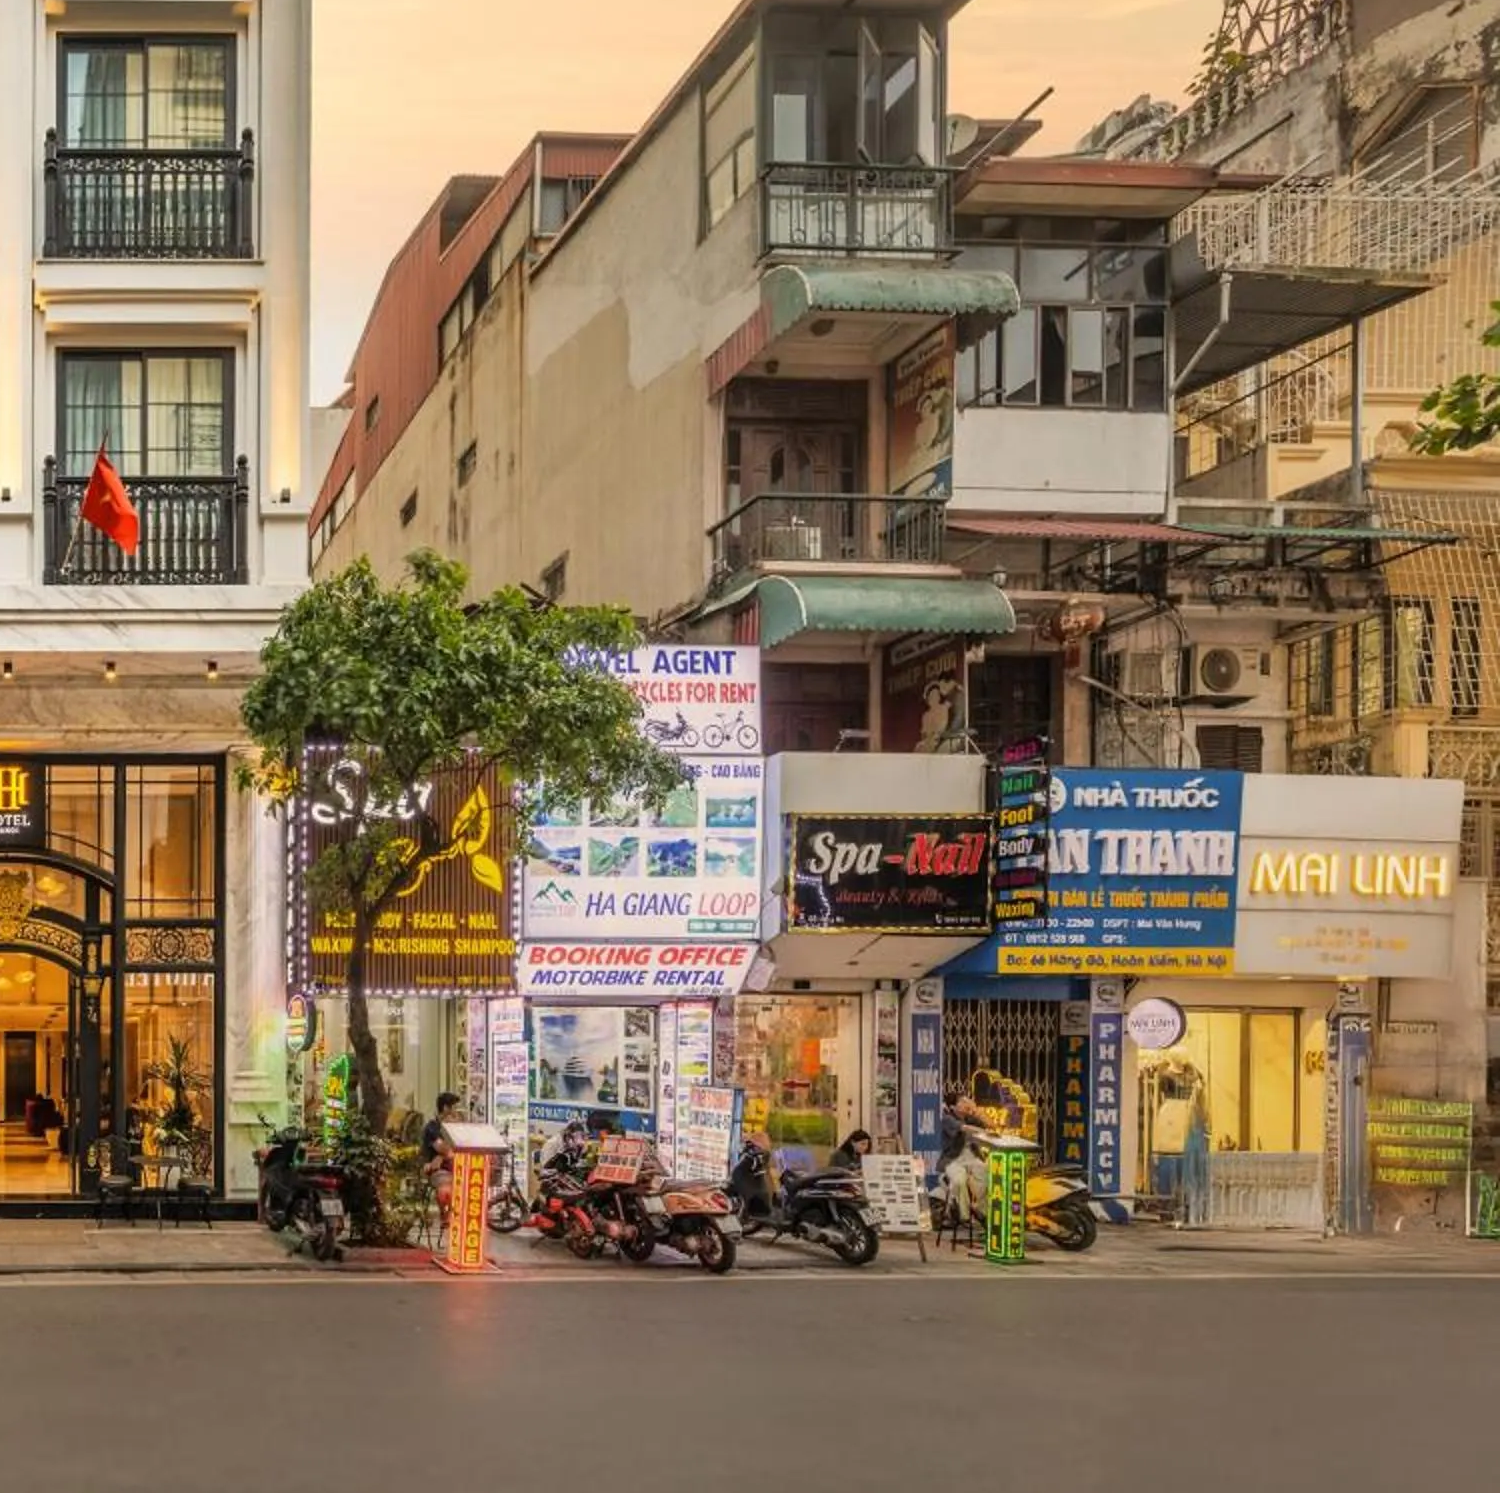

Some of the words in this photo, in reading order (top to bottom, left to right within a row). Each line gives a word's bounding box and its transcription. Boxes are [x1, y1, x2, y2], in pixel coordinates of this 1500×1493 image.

[652, 650, 737, 674] AGENT
[628, 681, 682, 704] YCLES
[685, 682, 716, 703] FOR
[719, 683, 757, 704] RENT
[1002, 774, 1034, 795] Nail
[1073, 780, 1129, 808] NHÀ
[1131, 777, 1220, 809] THUỐC
[1000, 805, 1035, 827] Foot
[999, 836, 1035, 857] Body
[1047, 829, 1091, 875] AN
[1094, 829, 1237, 876] THANH
[1250, 850, 1339, 896] MAI
[1352, 853, 1450, 898] LINH
[585, 892, 616, 917] HA
[622, 893, 692, 916] GIANG
[696, 893, 757, 916] LOOP
[376, 912, 404, 929] ODY
[412, 912, 457, 929] FACIAL
[468, 912, 499, 929] NAIL
[311, 937, 354, 954] WAXIN
[373, 937, 449, 955] NOURISHING
[454, 938, 517, 955] SHAMPOO
[527, 946, 652, 966] BOOKING
[656, 947, 748, 966] OFFICE
[530, 970, 649, 986] MOTORBIKE
[653, 970, 726, 986] RENTAL
[1063, 1036, 1085, 1160] PHARMA
[464, 1154, 485, 1263] MASSAGE
